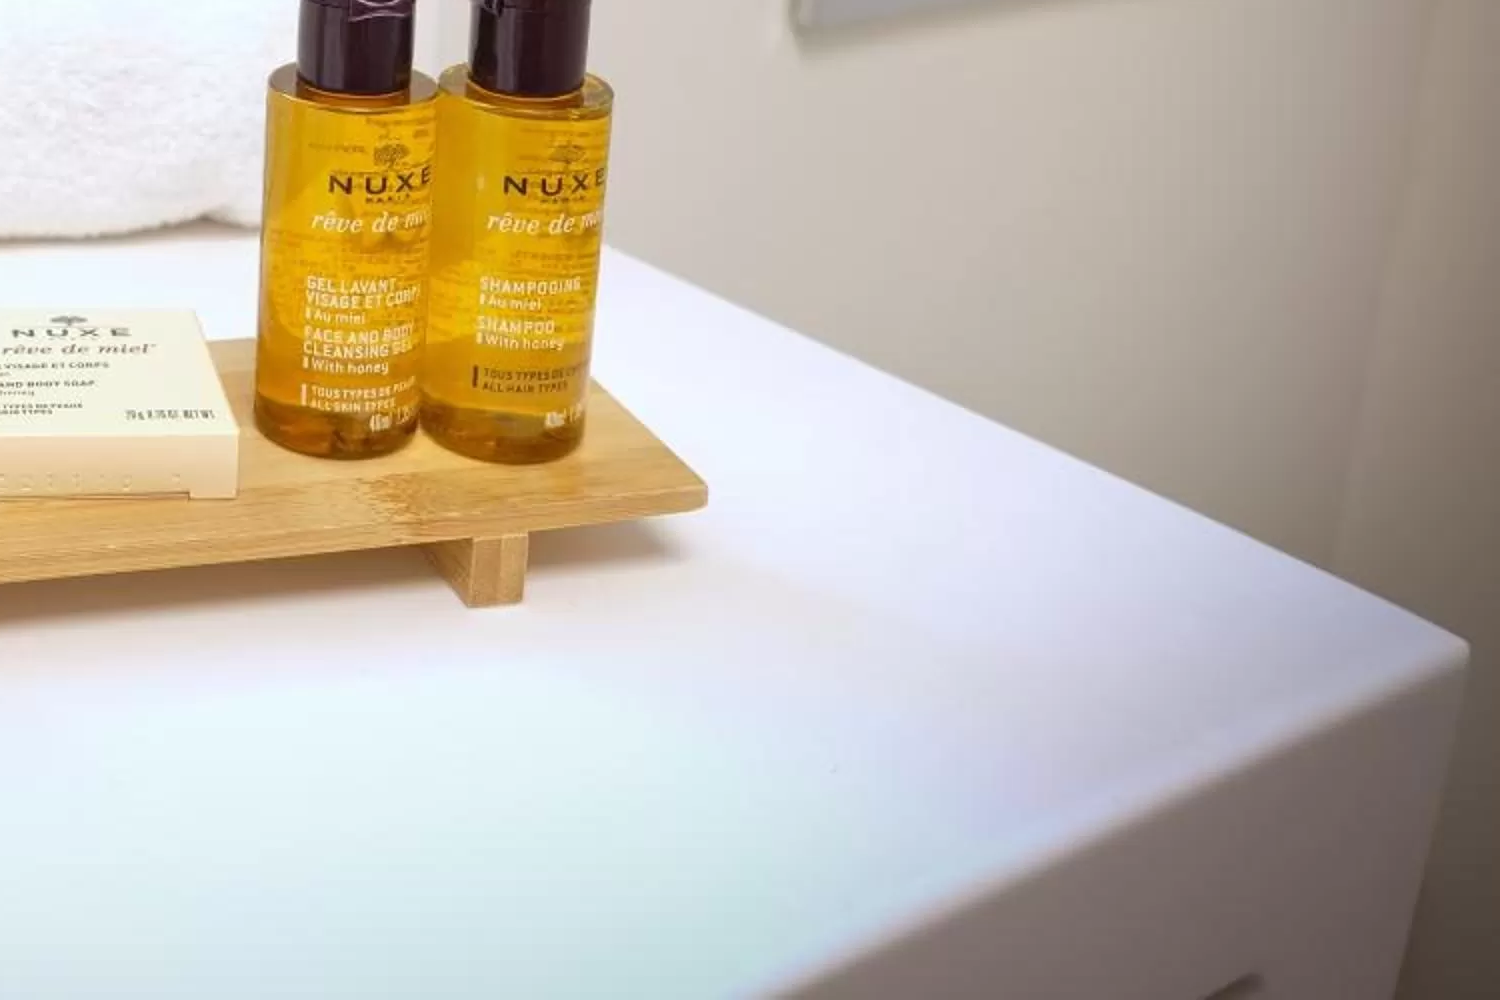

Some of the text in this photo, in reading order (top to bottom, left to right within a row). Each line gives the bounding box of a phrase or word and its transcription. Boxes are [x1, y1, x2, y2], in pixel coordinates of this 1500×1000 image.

[328, 164, 431, 194] NUXE
[503, 167, 605, 196] NUXE
[311, 210, 363, 233] rêve
[371, 210, 398, 233] de
[487, 211, 540, 233] rêve
[548, 212, 575, 235] de
[307, 275, 397, 294] GEL LAVANT
[480, 276, 581, 296] SHAMPOOING
[306, 289, 361, 309] VISAGE
[365, 295, 383, 309] ET
[488, 294, 541, 311] Au miel
[314, 308, 366, 325] Au miel
[477, 316, 556, 335] SHAMPOO
[11, 327, 133, 338] NUXE
[304, 319, 415, 344] FACE AND BODY
[303, 341, 390, 359] CLEANSING
[485, 334, 565, 351] With honey
[311, 357, 389, 376] With honey
[483, 367, 513, 380] TOUS
[516, 370, 549, 381] TYPES
[63, 379, 95, 387] SOAP
[311, 386, 341, 399] TOUS
[342, 388, 377, 399] TYPES
[483, 381, 504, 393] ALL
[506, 383, 535, 393] HAIR
